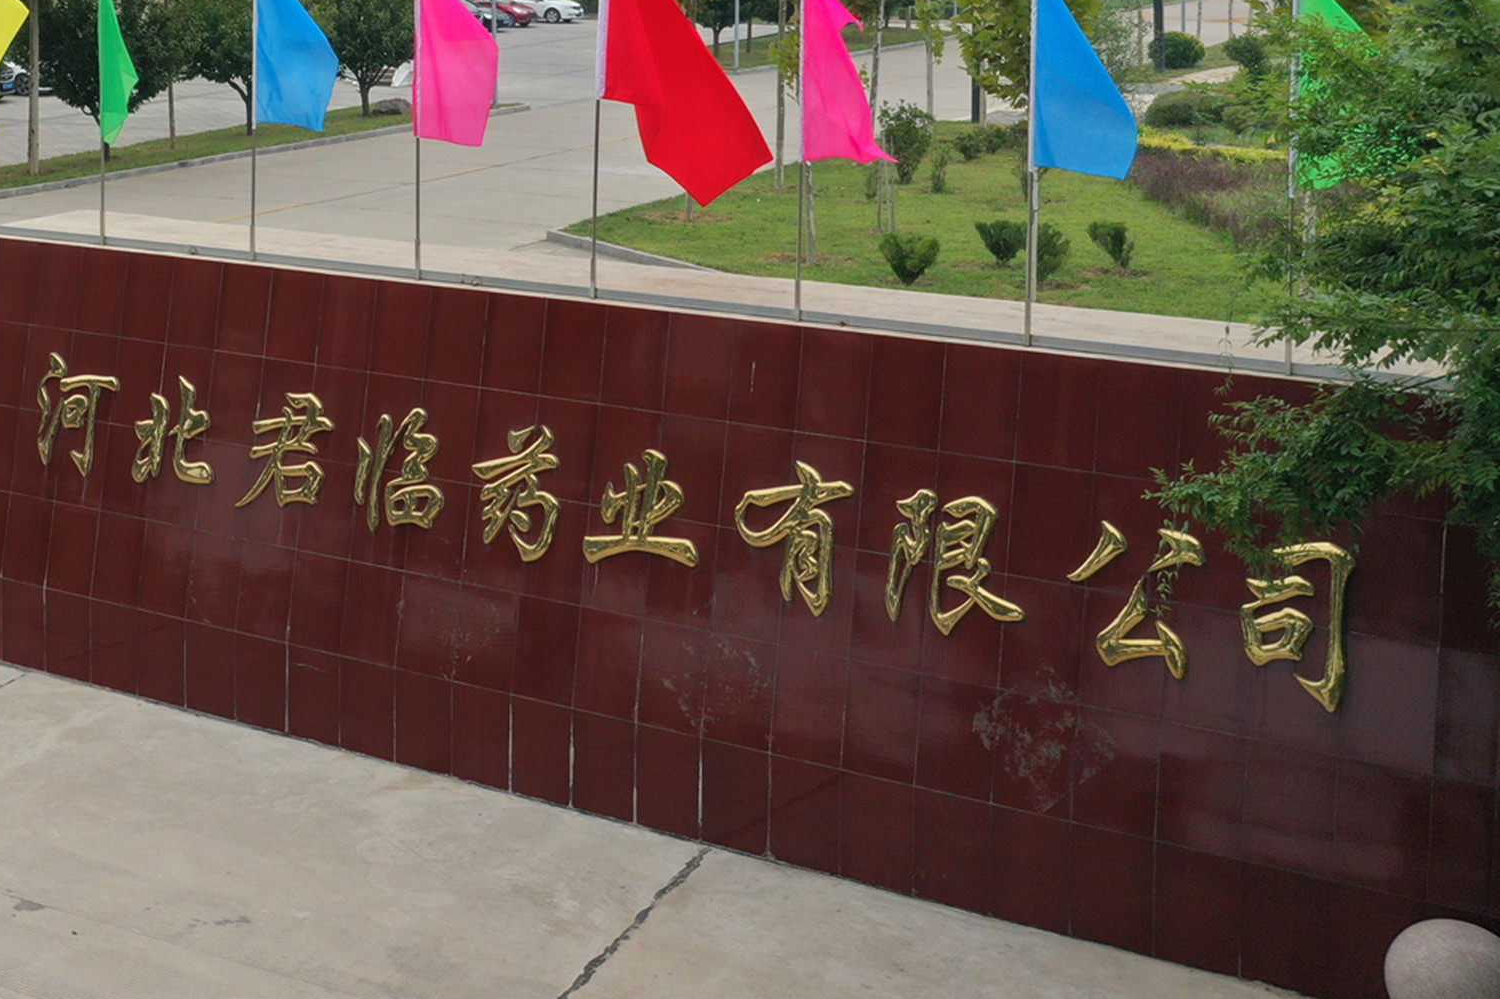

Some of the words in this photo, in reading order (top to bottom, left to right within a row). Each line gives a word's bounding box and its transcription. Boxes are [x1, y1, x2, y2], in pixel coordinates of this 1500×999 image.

[36, 351, 1356, 713] 河北君临药业有限公司
